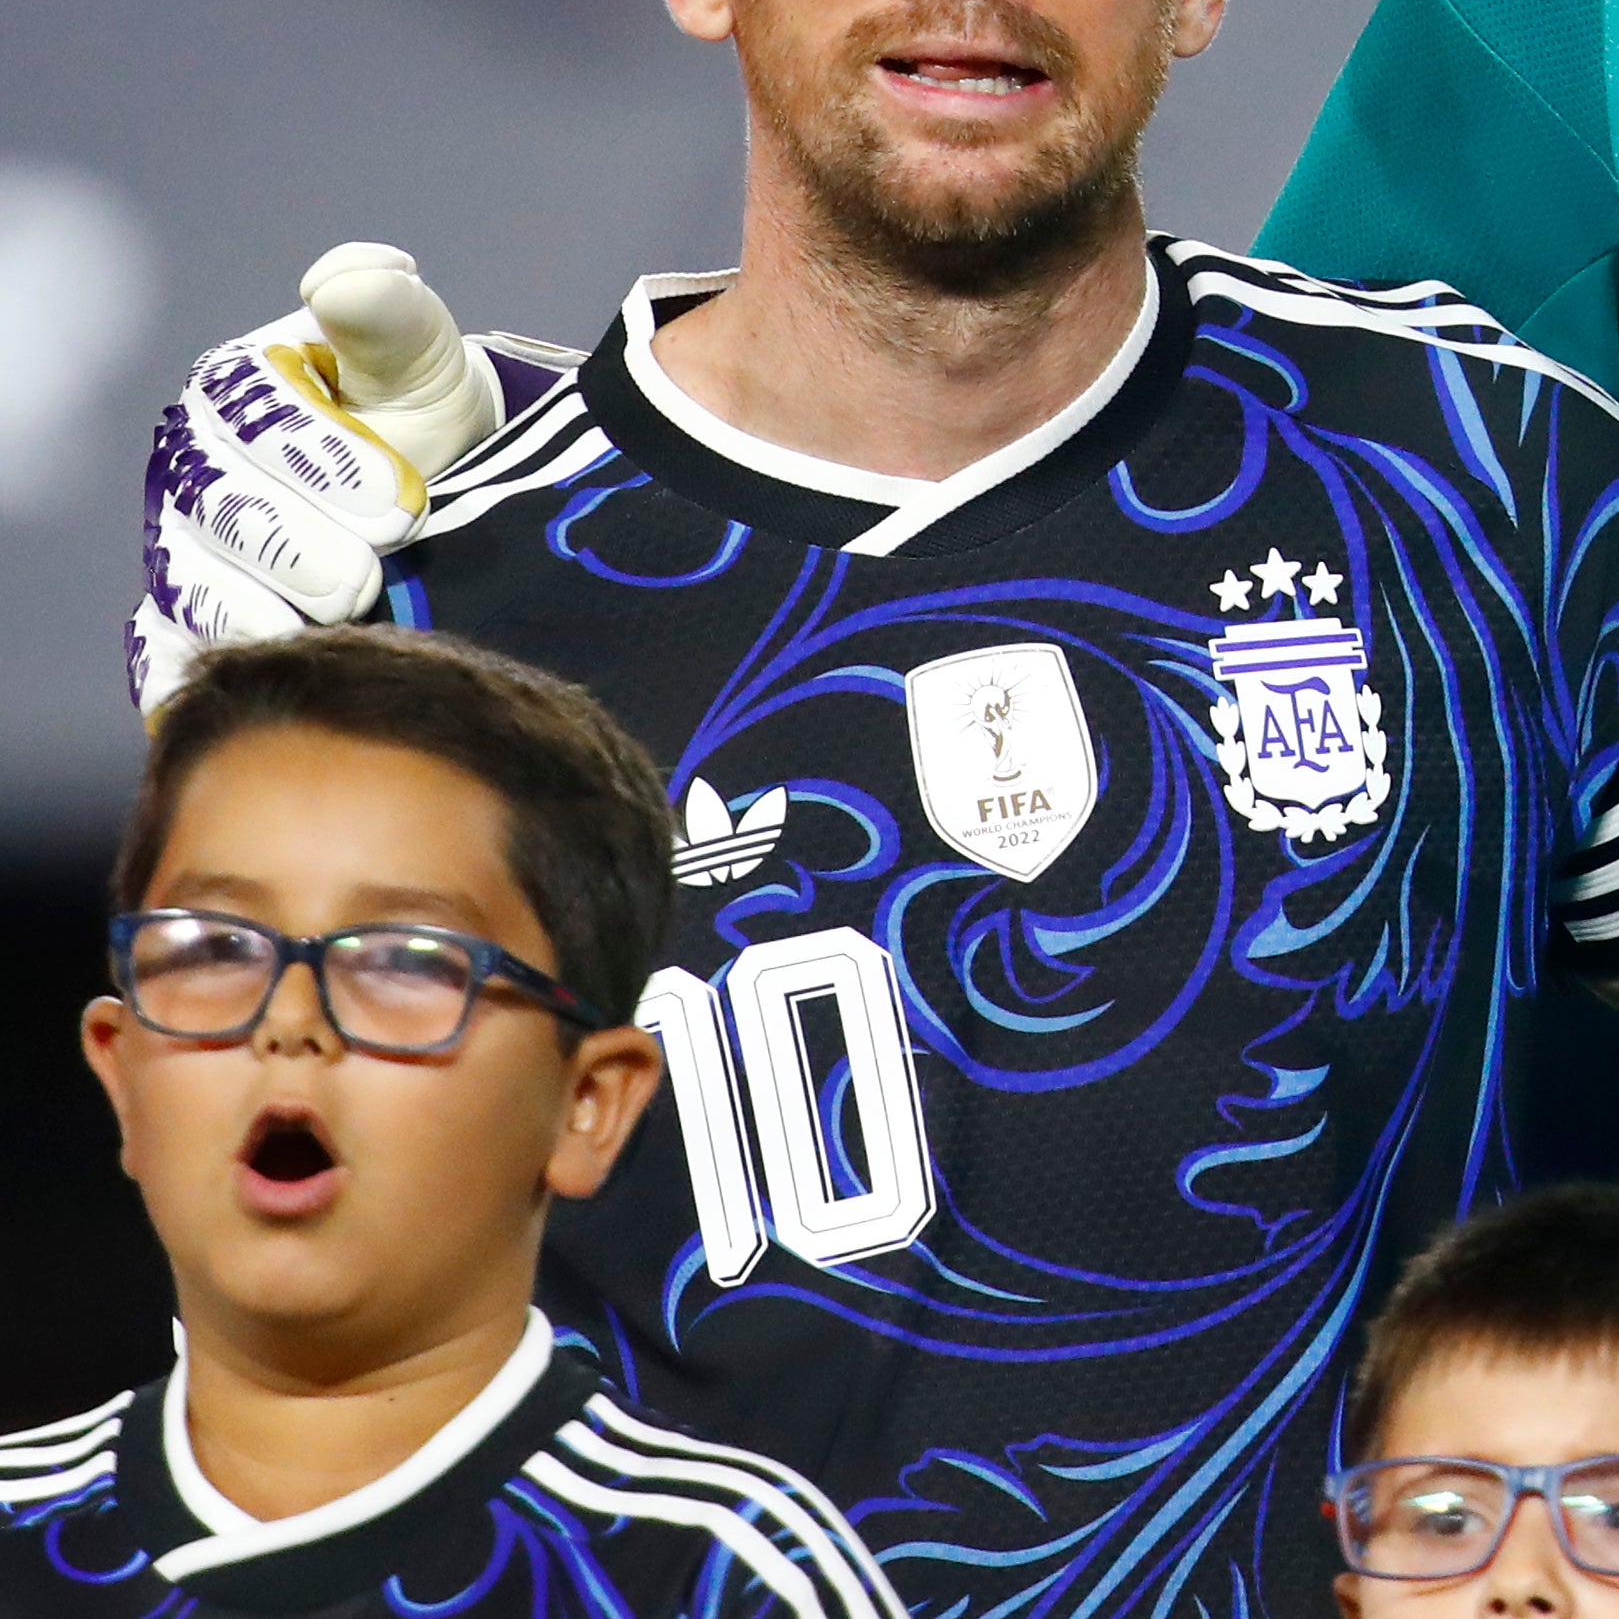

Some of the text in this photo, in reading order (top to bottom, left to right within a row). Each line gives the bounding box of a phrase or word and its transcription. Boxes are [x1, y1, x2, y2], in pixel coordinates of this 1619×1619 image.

[1257, 676, 1354, 773] AFA
[977, 789, 1052, 823] FIFA
[962, 812, 1072, 838] WORLD CHAMPIONS
[997, 829, 1041, 849] 2022
[634, 926, 938, 1288] 10
